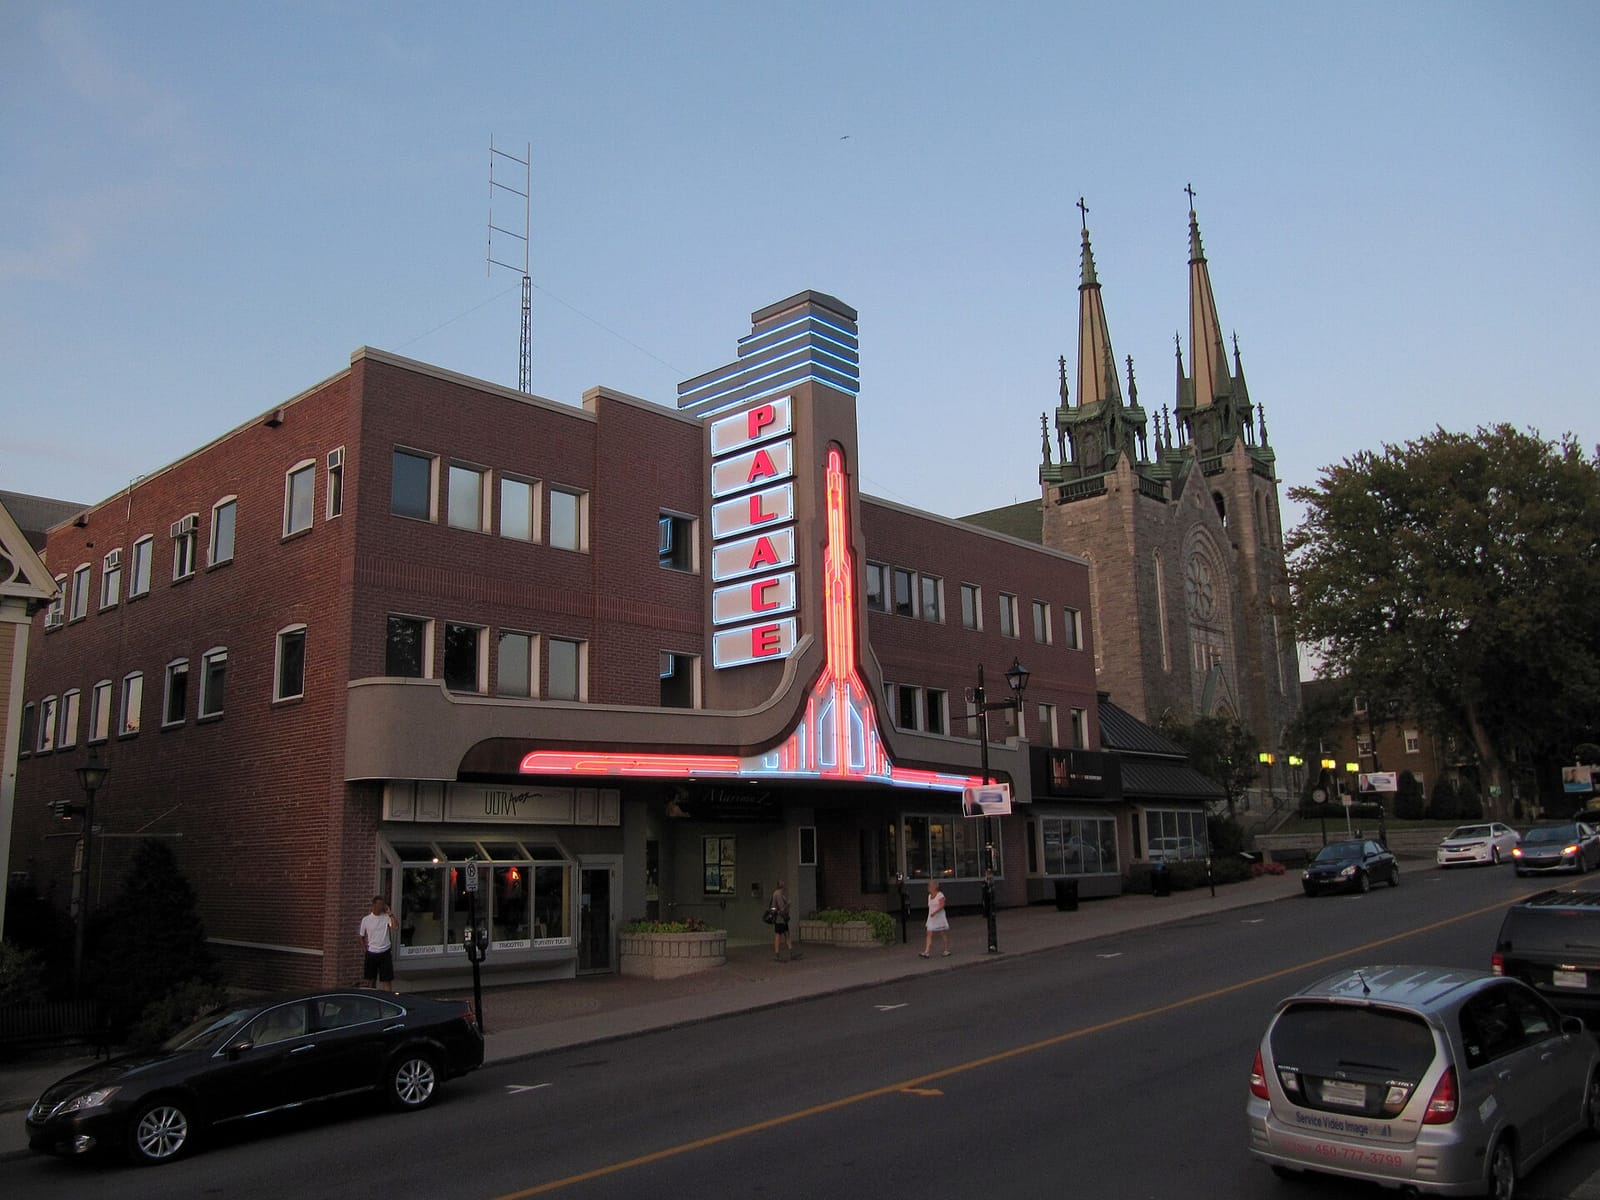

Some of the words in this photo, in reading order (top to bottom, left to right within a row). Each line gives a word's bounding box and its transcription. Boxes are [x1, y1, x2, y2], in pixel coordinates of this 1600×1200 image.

[748, 404, 780, 657] PALACE
[1295, 1111, 1323, 1127] Service
[1345, 1119, 1368, 1136] Image
[1315, 1142, 1402, 1168] 450-777-3799
